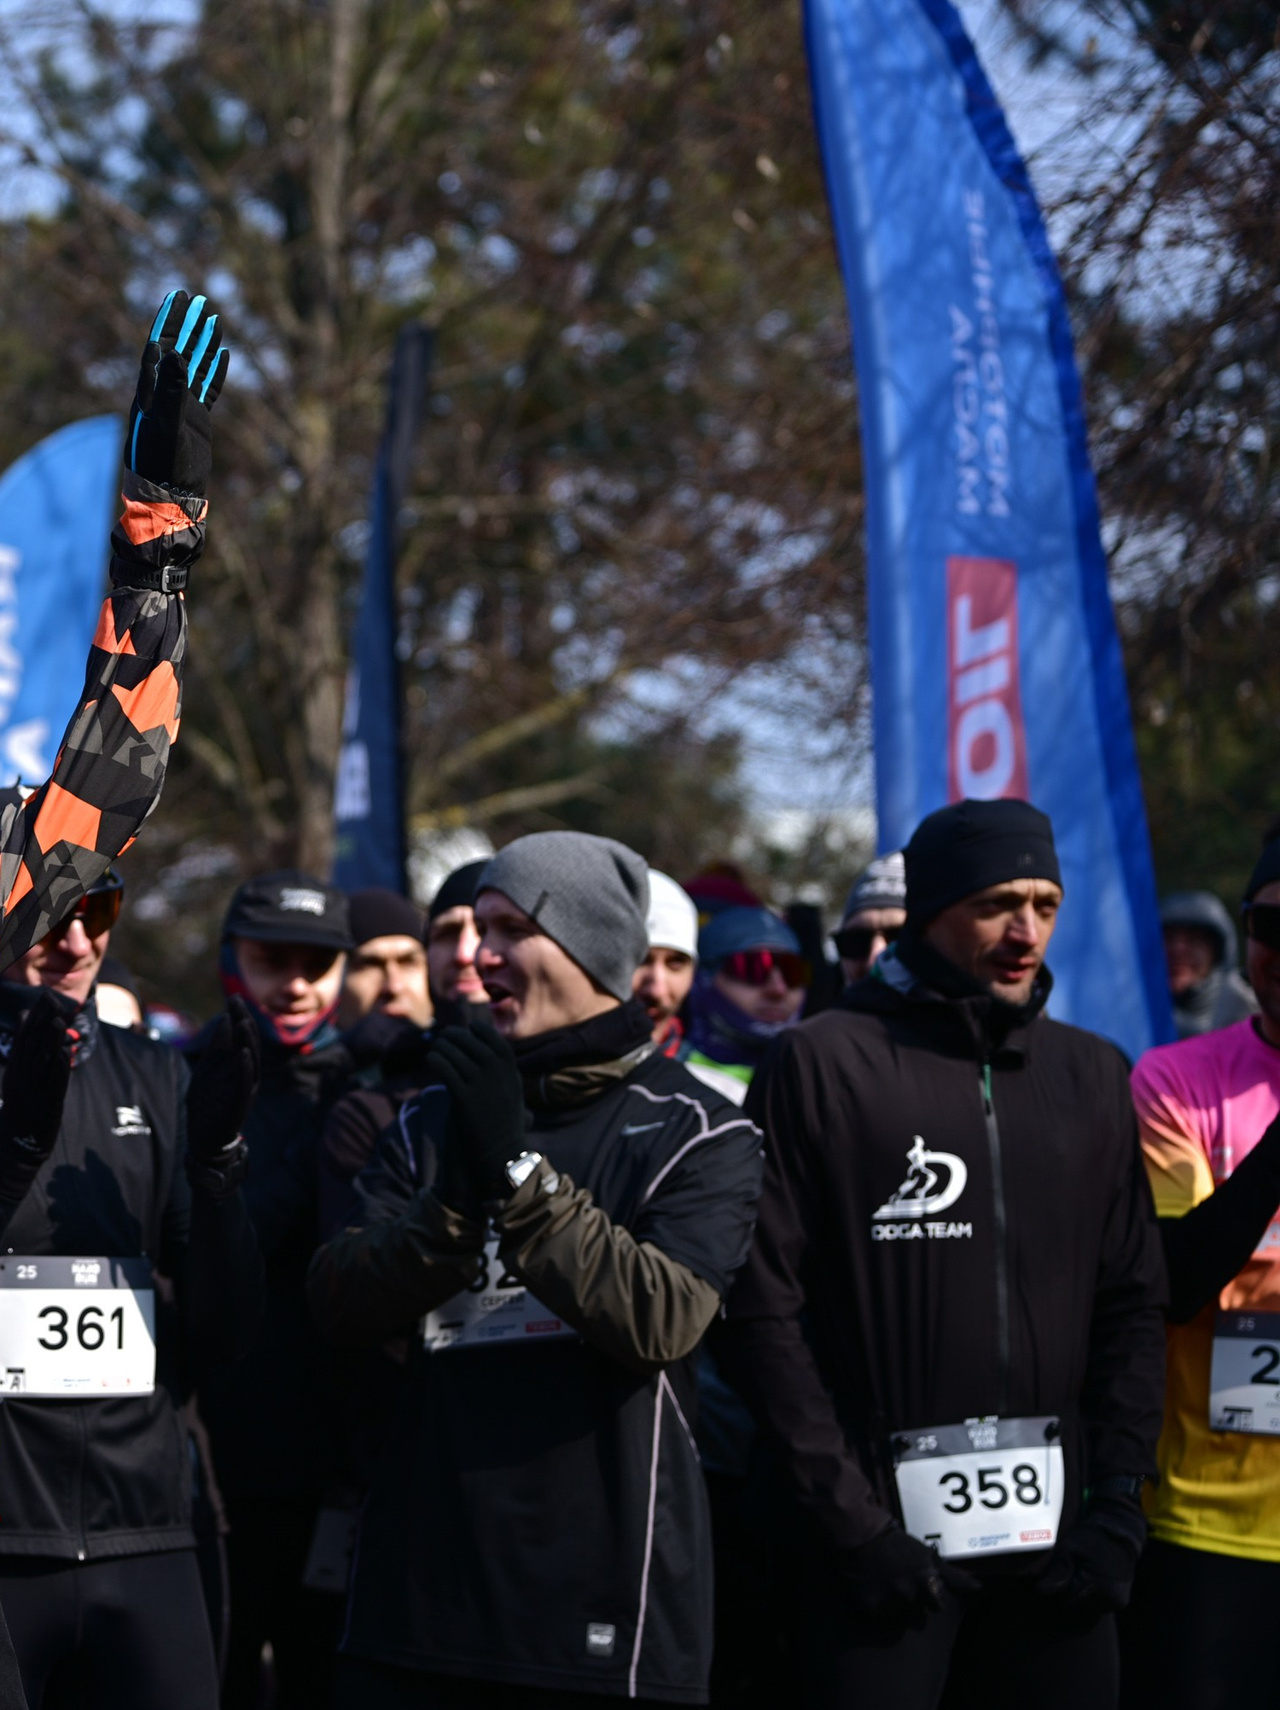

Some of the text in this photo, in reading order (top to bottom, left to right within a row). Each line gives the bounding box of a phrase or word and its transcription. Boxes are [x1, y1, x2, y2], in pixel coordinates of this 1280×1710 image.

[925, 1222, 972, 1239] TEAM
[16, 1264, 38, 1280] 25
[37, 1305, 125, 1351] 361
[917, 1435, 938, 1451] 25
[939, 1464, 1042, 1514] 358
